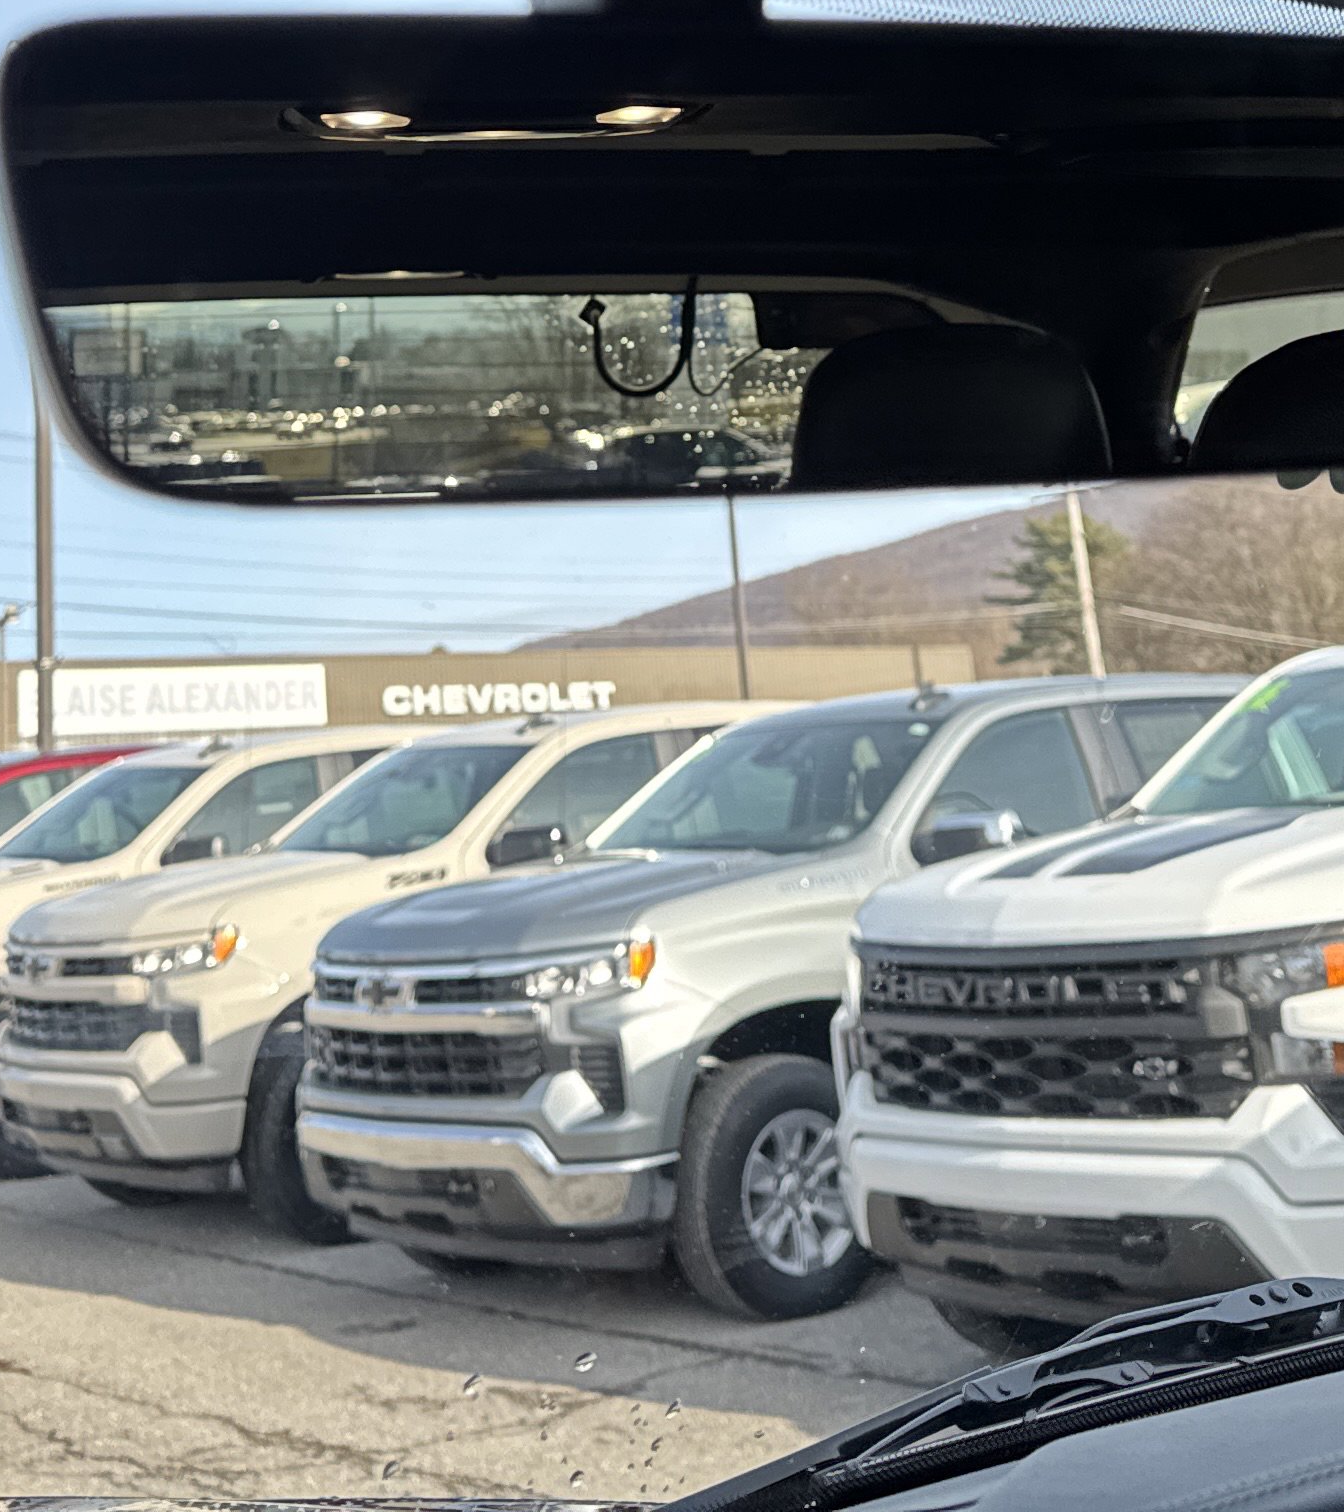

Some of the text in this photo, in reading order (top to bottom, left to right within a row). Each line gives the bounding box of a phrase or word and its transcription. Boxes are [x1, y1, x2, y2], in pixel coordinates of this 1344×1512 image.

[49, 679, 318, 718] AISE ALEXANDER
[381, 681, 617, 717] CHEVROLET
